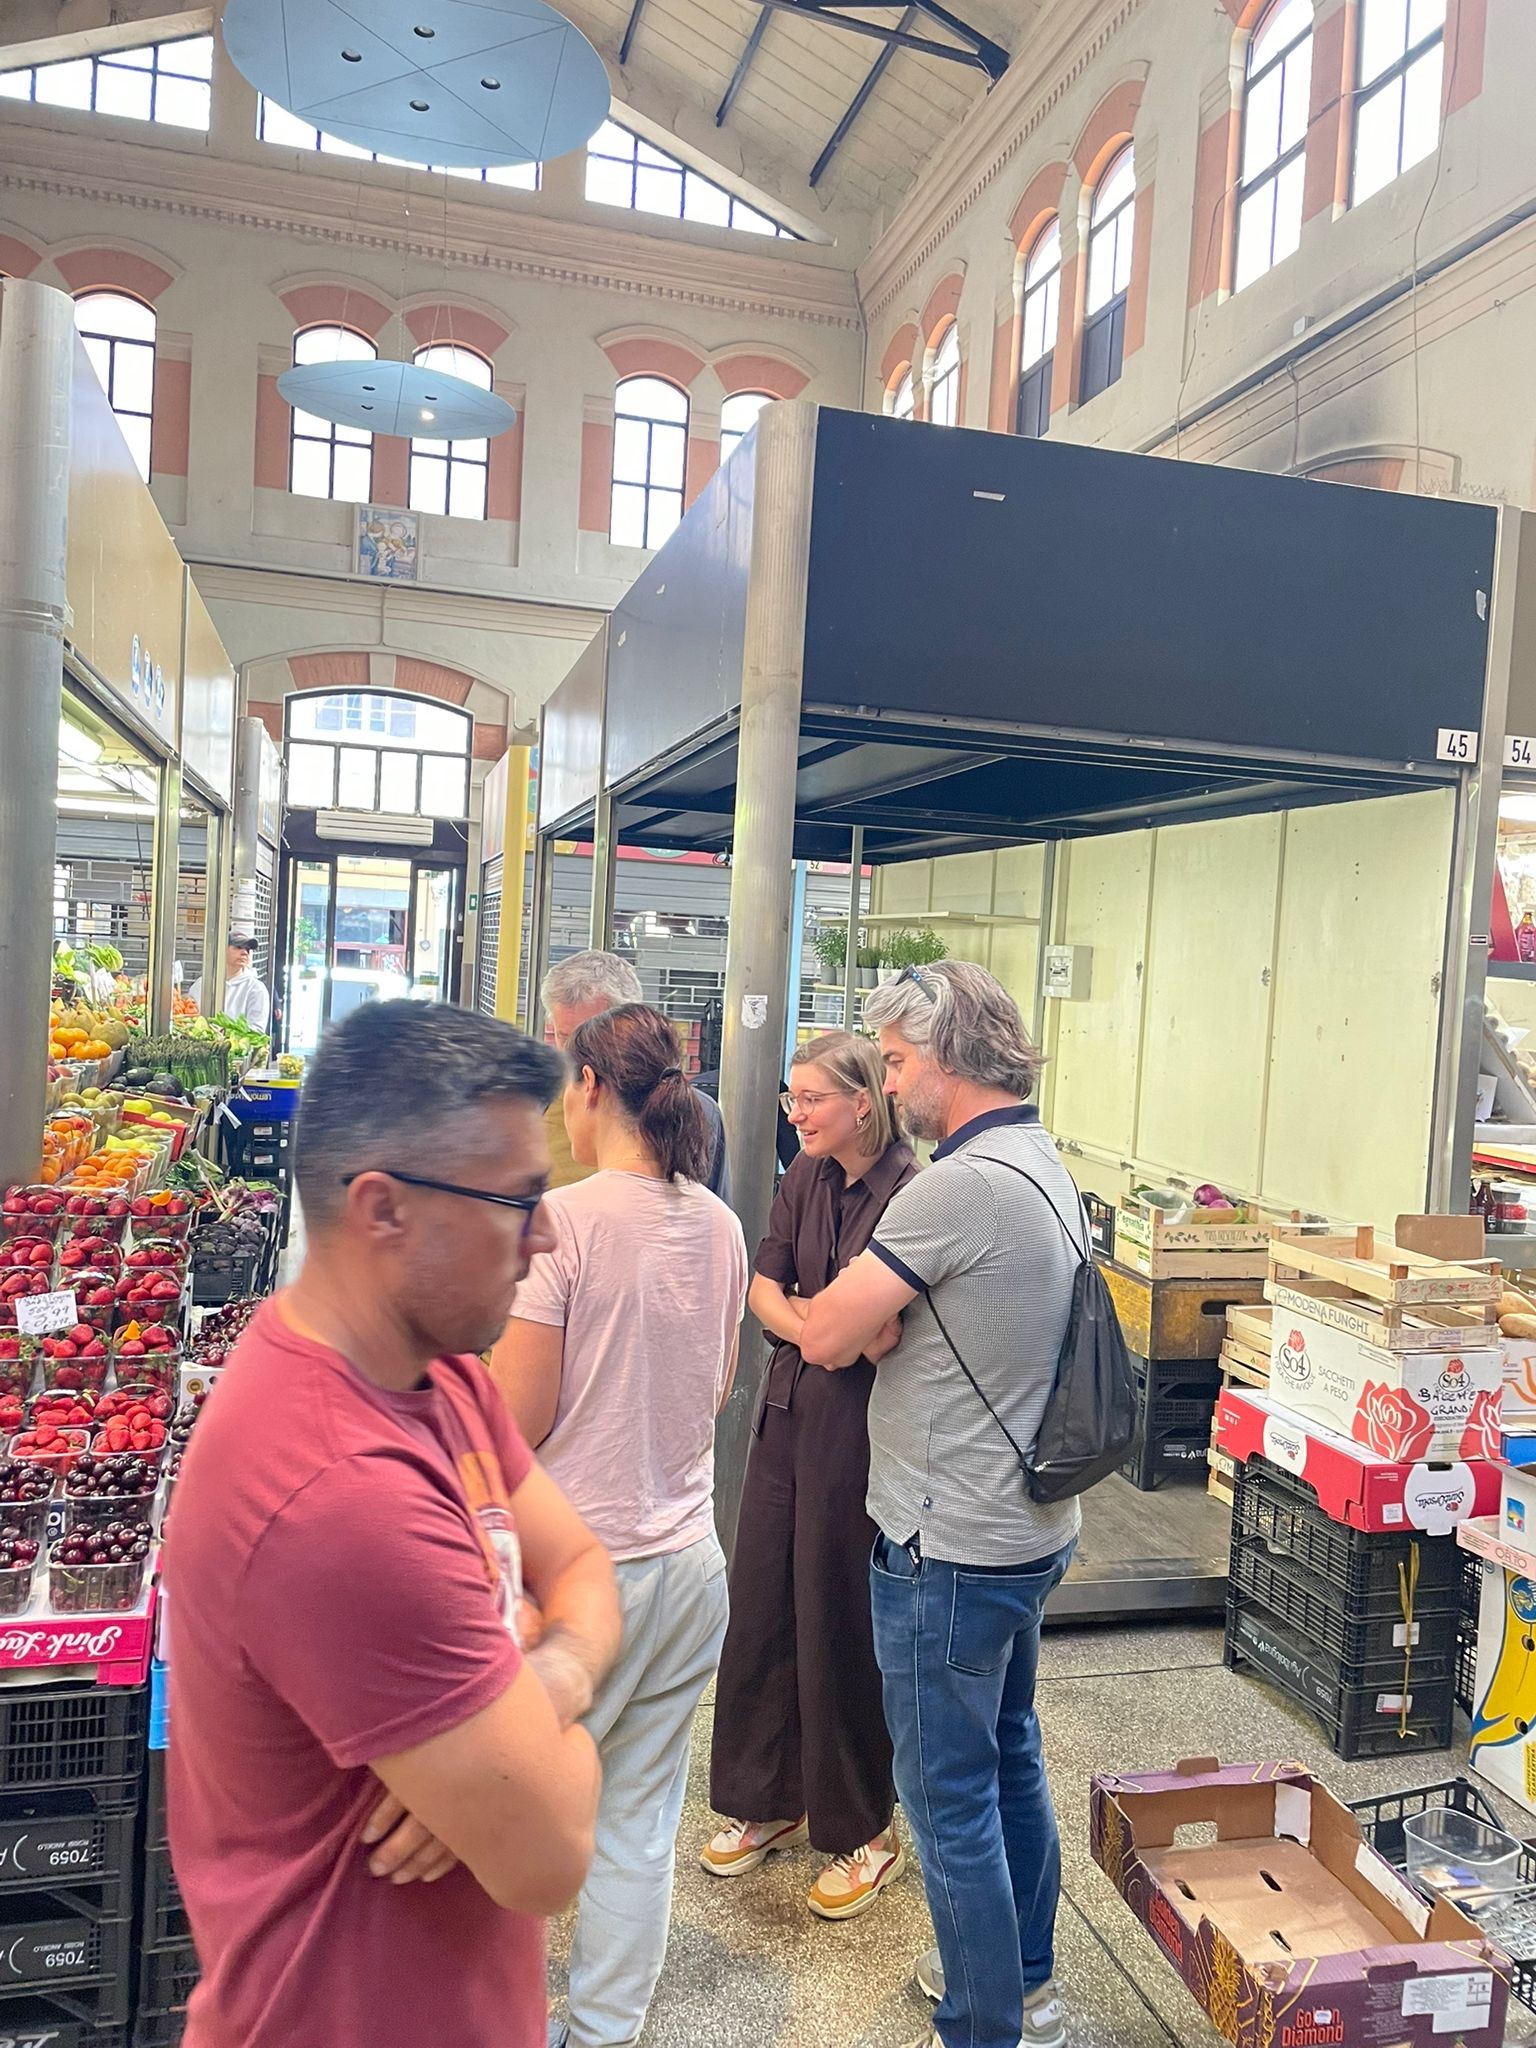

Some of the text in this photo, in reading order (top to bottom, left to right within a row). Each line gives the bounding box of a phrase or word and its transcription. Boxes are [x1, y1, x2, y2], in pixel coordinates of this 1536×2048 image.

[1447, 733, 1468, 758] 45
[1511, 739, 1531, 764] 54
[1286, 1292, 1370, 1336] MODENA FUNGHI
[1318, 1365, 1355, 1391] SACCHETTI
[1322, 1382, 1349, 1402] A PESO
[46, 1626, 122, 1659] Pink
[49, 1848, 90, 1866] 7059
[45, 1949, 85, 1968] 7059
[1296, 2005, 1340, 2028] Goln
[1281, 2020, 1345, 2047] Diamond
